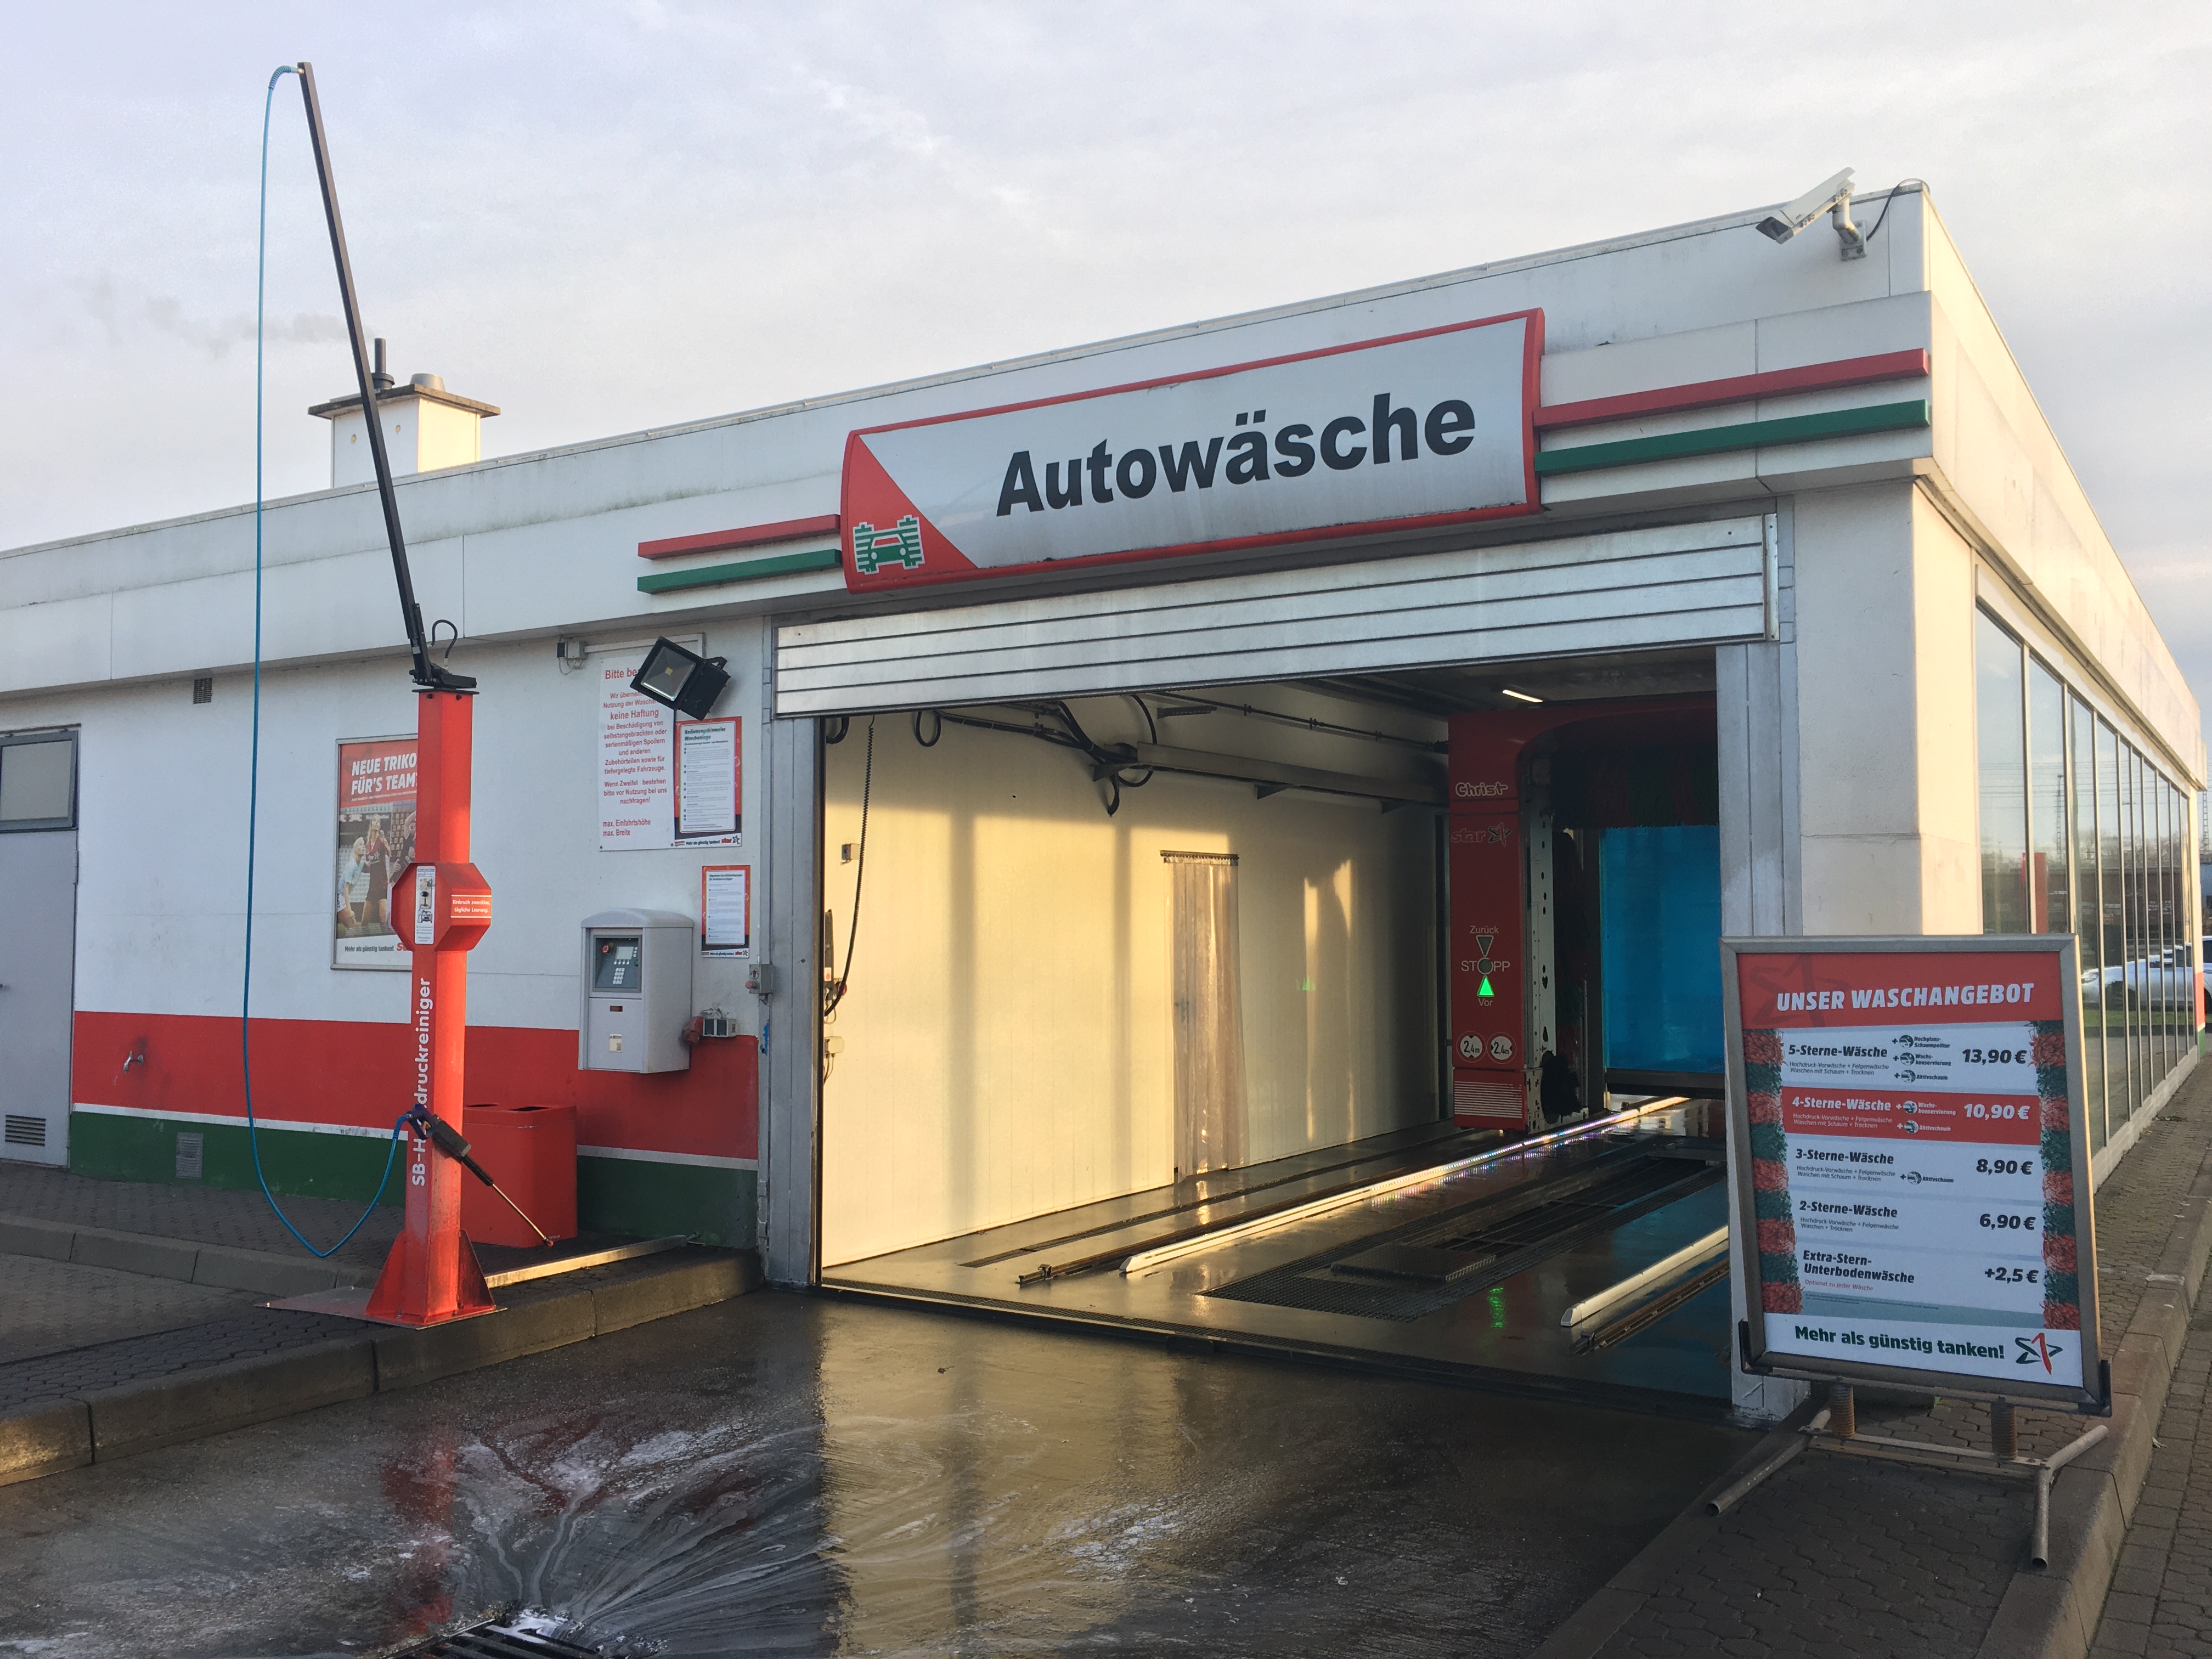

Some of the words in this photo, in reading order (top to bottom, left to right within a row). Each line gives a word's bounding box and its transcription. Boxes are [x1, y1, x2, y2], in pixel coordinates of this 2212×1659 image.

[996, 392, 1476, 516] Autowäsche
[605, 669, 624, 680] Bitte
[627, 668, 637, 678] be
[610, 712, 629, 720] keine
[631, 709, 659, 718] Haftung
[604, 731, 654, 740] selbstangebrachten
[352, 758, 381, 776] NEUE
[384, 753, 417, 771] TRIKO
[605, 758, 640, 766] Zubehörteilen
[605, 767, 636, 775] tiefergelegte
[351, 776, 382, 795] FÜR'S
[386, 772, 417, 790] TEAM
[1455, 782, 1508, 797] Christ
[1451, 828, 1486, 843] star
[1470, 926, 1499, 934] Zurück
[1462, 958, 1510, 974] STOPP
[1479, 998, 1493, 1007] Vor
[1777, 991, 1844, 1011] UNSER
[1852, 983, 2034, 1008] WASCHANGEBOT
[1788, 1045, 1888, 1058] 5-Sterne-Wäsche
[1962, 1049, 2012, 1065] 13,90
[2015, 1049, 2028, 1064] €
[413, 978, 433, 1186] SB-Hdruckreiniger
[1792, 1097, 1891, 1111] 4-Sterne-Wäsche
[1964, 1104, 2015, 1120] 10,90
[2017, 1105, 2030, 1120] €
[1796, 1148, 1894, 1164] 3-Sterne-Wäsche
[1797, 1165, 1853, 1174] Hochdruck-Vorwäsche
[1976, 1159, 2018, 1176] 8,90
[2021, 1160, 2033, 1175] €
[1799, 1200, 1898, 1218] 2-Sterne-Wäsche
[1800, 1217, 1857, 1227] Hochdruck-Vorwäsche
[1862, 1221, 1899, 1230] Felgenwäsche
[1979, 1214, 2021, 1230] 6,90
[2023, 1216, 2036, 1230] €
[1803, 1250, 1872, 1266] Extra-Stern-
[1804, 1263, 1915, 1283] Unterbodenwäsche
[1985, 1267, 2023, 1284] +2,5
[2026, 1269, 2039, 1284] €
[1805, 1279, 1827, 1287] Optional
[1852, 1283, 1874, 1291] Wäsche
[1795, 1325, 1836, 1343] Mehr
[1841, 1330, 1865, 1346] als
[1869, 1334, 1933, 1354] günstig
[1938, 1339, 2005, 1359] tanken!
